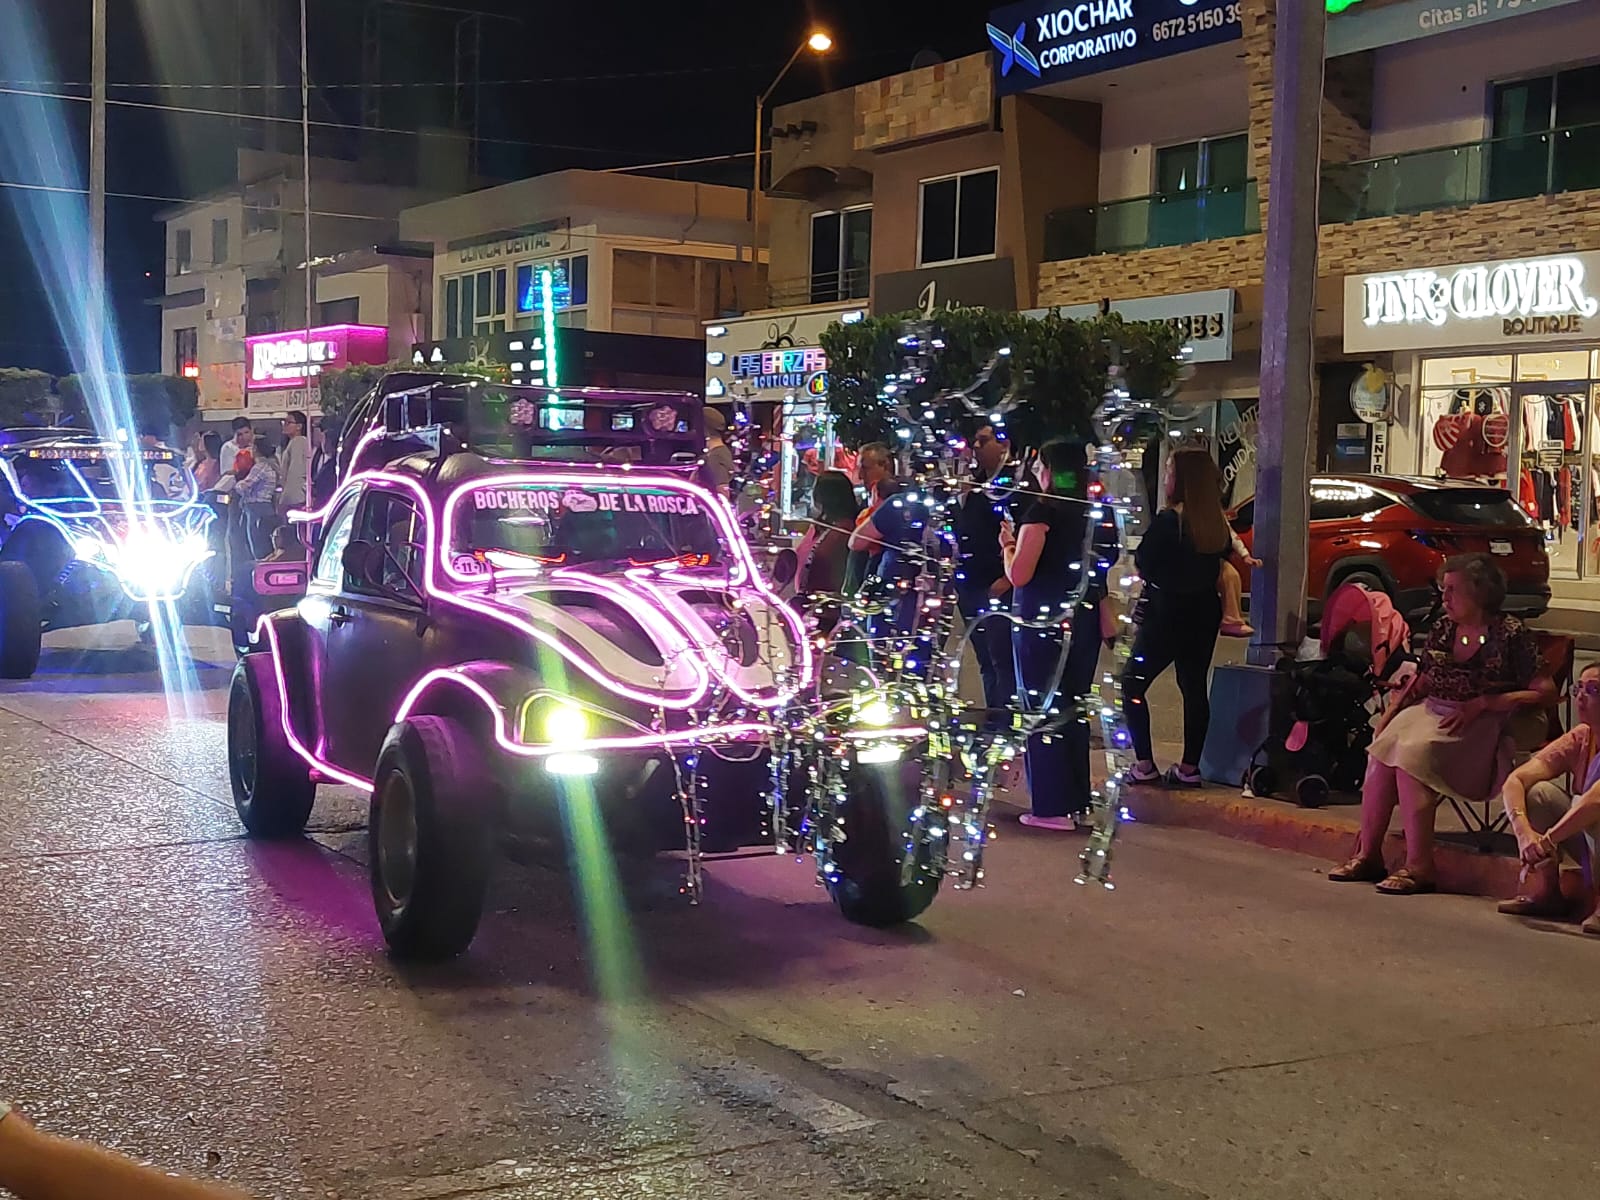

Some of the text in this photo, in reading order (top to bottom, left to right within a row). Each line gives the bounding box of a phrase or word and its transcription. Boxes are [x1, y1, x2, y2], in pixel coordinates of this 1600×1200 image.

[1036, 0, 1134, 42] XIOCHAR
[1152, 18, 1185, 42] 6672
[1187, 10, 1224, 33] 5150
[1419, 7, 1462, 29] Citas
[1467, 1, 1488, 18] al:
[1040, 28, 1137, 69] CORPORATIVO
[1363, 258, 1598, 326] PINK CLOVER
[1503, 314, 1583, 336] BOUTIQUE
[731, 353, 761, 376] LAS
[474, 491, 699, 515] BOCHEROS DE LA ROSCA
